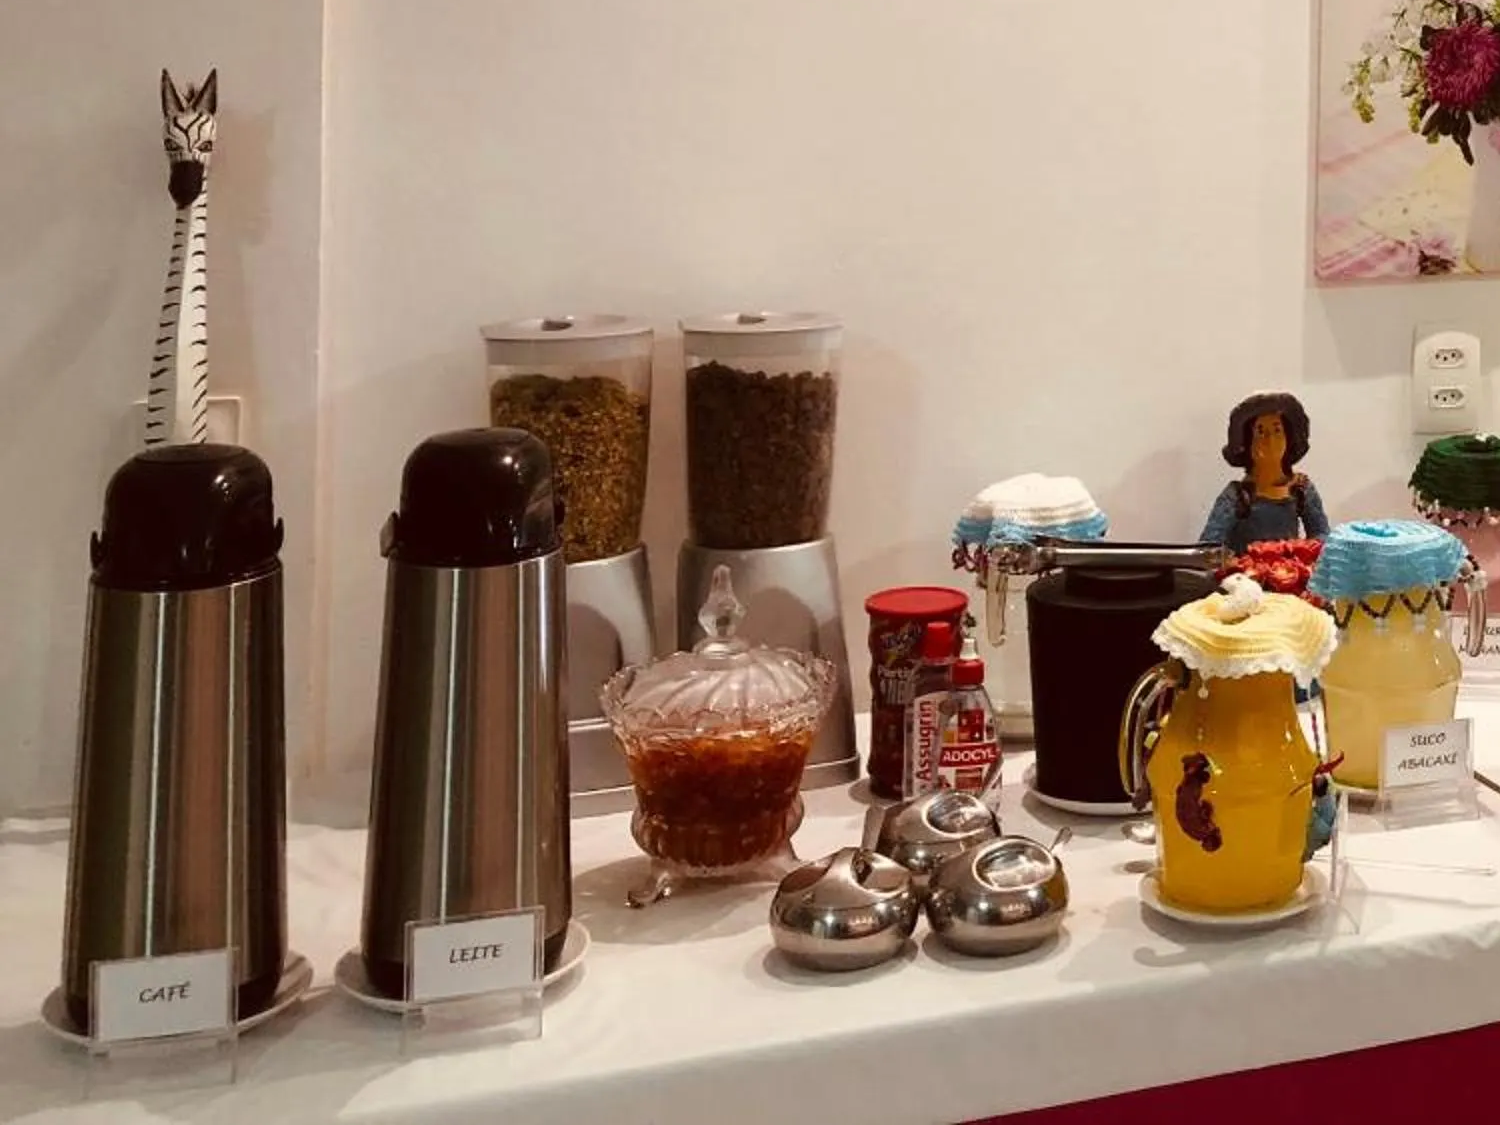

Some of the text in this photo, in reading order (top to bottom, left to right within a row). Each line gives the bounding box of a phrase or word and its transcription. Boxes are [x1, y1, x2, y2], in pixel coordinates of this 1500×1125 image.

[916, 700, 940, 782] Assugrin
[1409, 732, 1447, 748] SUCO
[942, 748, 997, 763] ADOCYL
[1397, 751, 1458, 772] ABACAXI
[449, 943, 505, 964] LEITE
[138, 980, 191, 1004] CAFÉ
